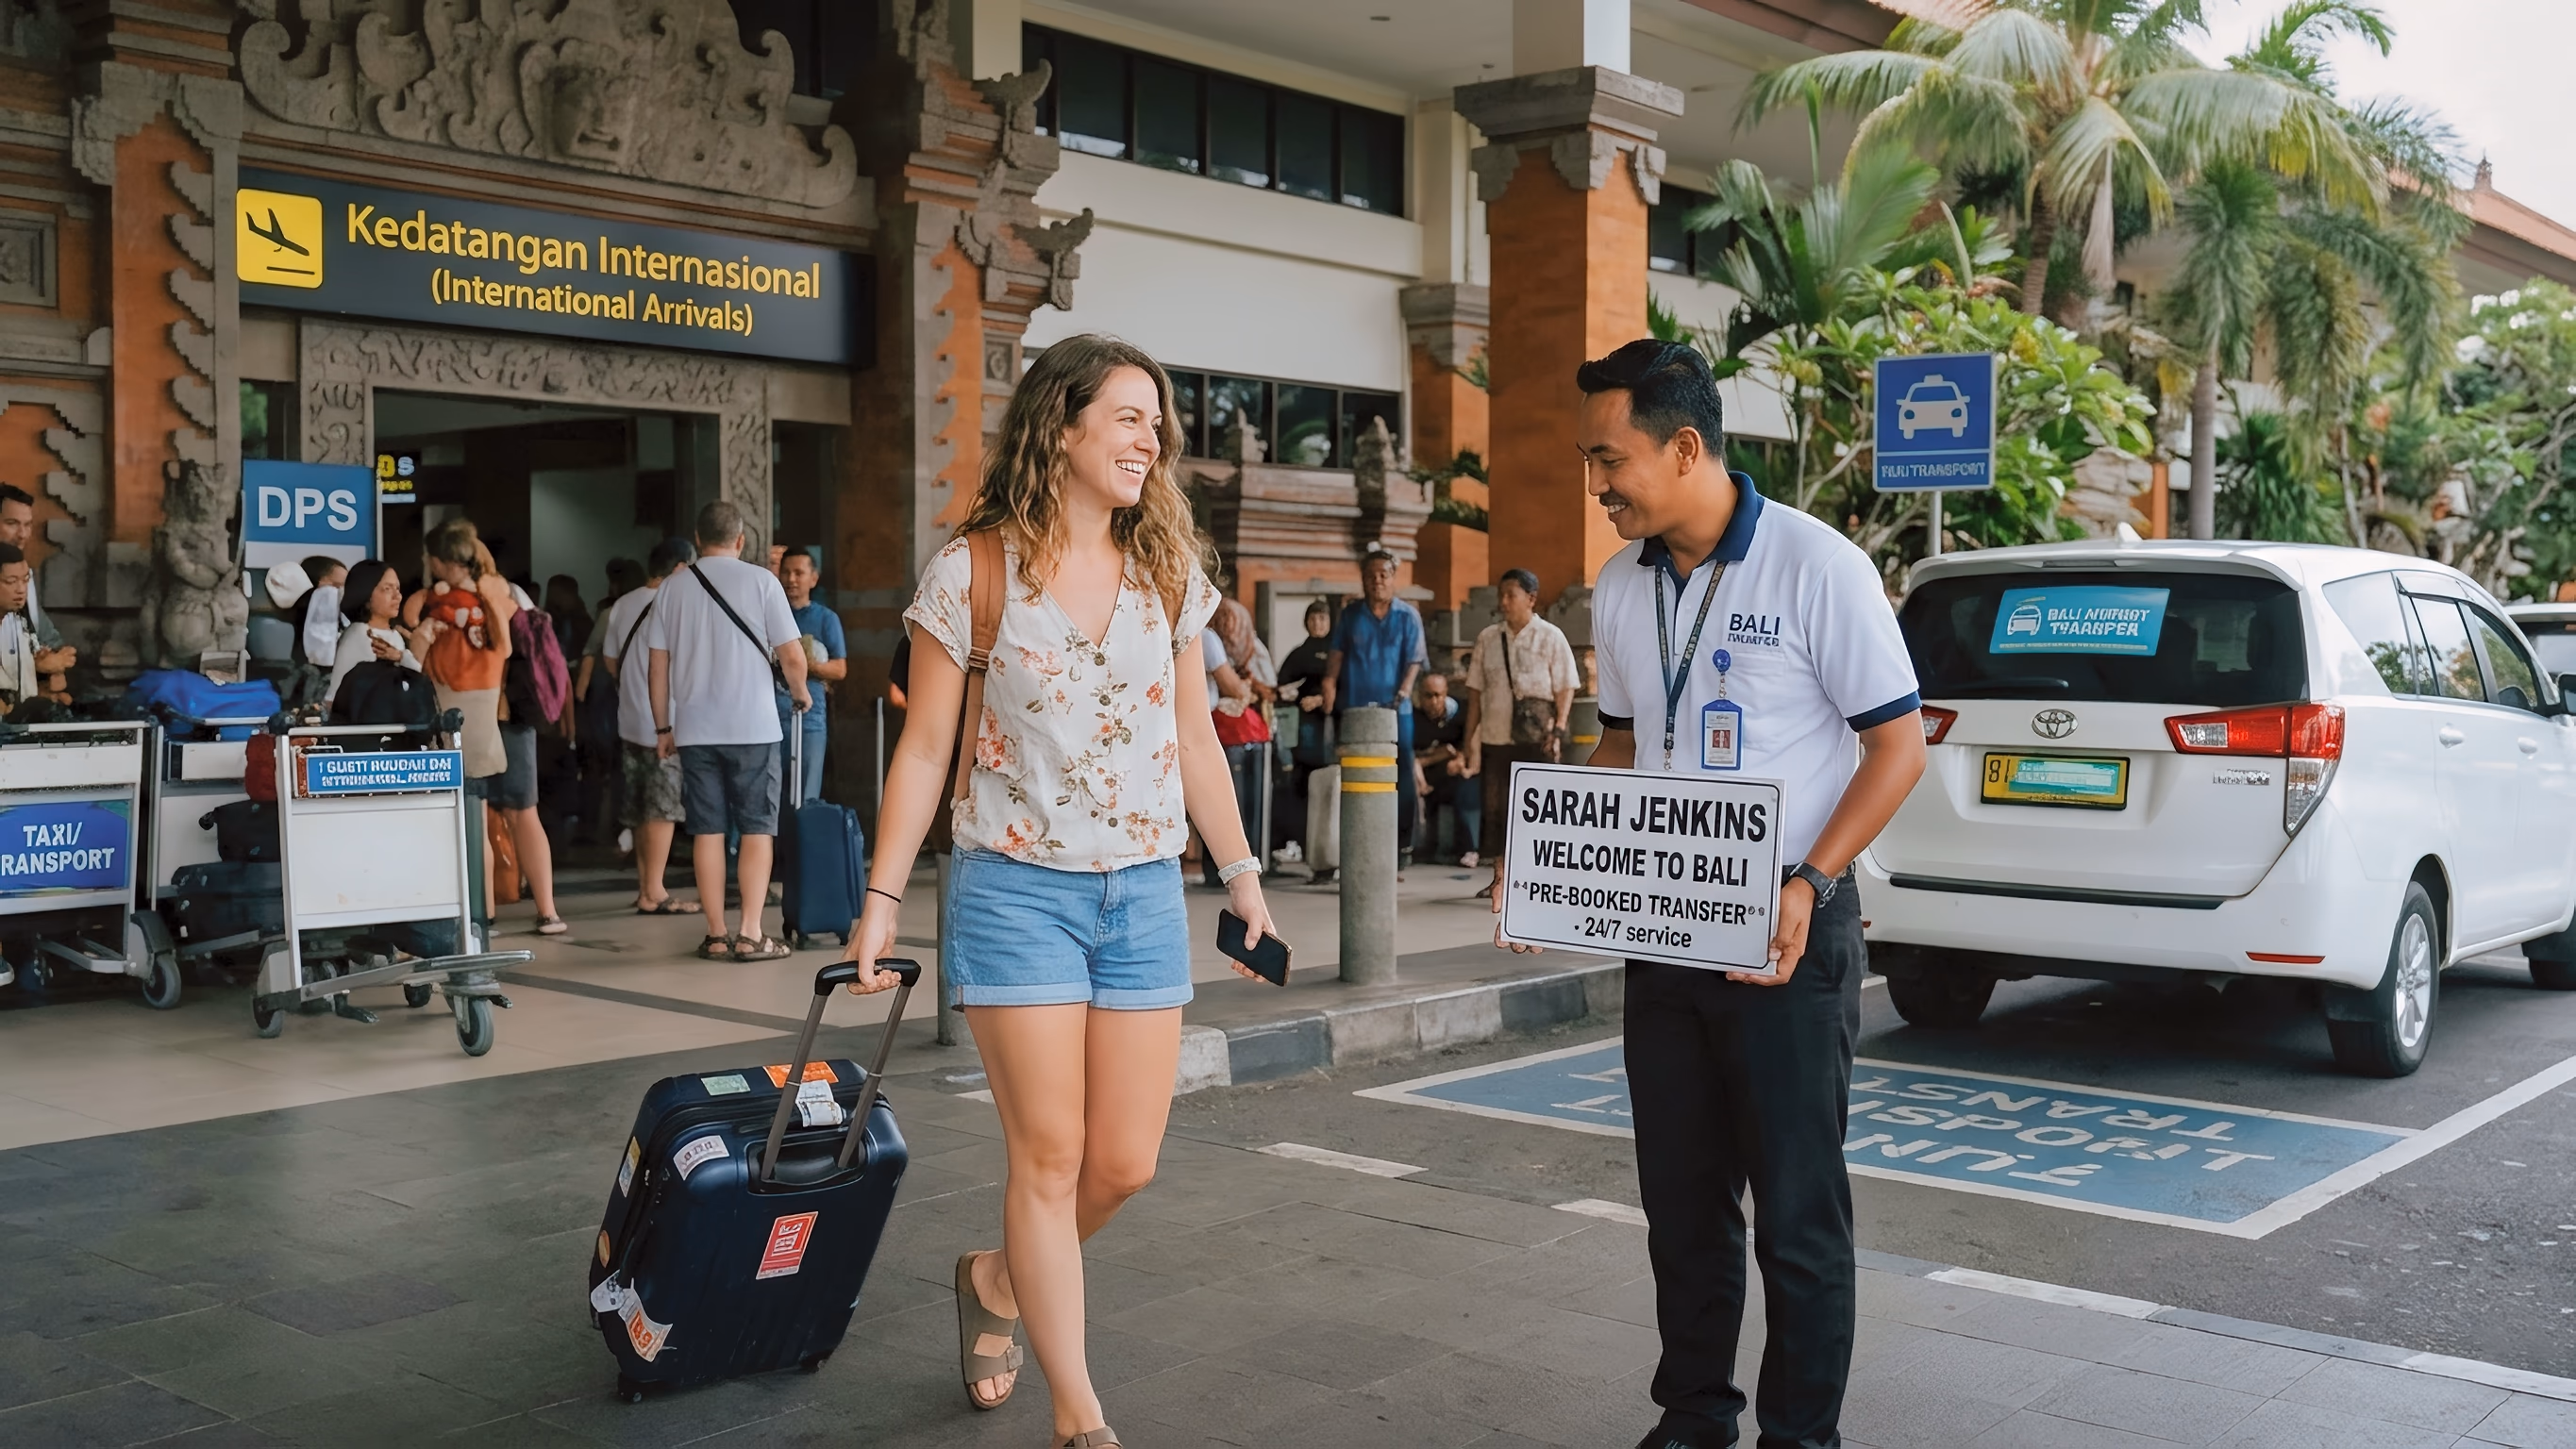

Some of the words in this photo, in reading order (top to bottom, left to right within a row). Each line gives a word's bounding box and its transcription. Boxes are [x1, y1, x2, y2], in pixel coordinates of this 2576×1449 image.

[347, 203, 588, 275] Kedatangan
[599, 236, 820, 299] Internasional
[431, 269, 635, 321] (International
[643, 294, 753, 337] Arrivals)
[258, 486, 358, 531] DPS
[1729, 613, 1781, 636] BALI
[1522, 787, 1621, 830] SARAH
[1630, 795, 1766, 842] JENKINS
[1, 847, 115, 876] RANSPORT
[1532, 839, 1647, 876] WELCOME
[1654, 851, 1684, 880] TO
[1693, 854, 1748, 887] BALI
[1584, 916, 1622, 941] 24/7
[1626, 925, 1693, 948] service
